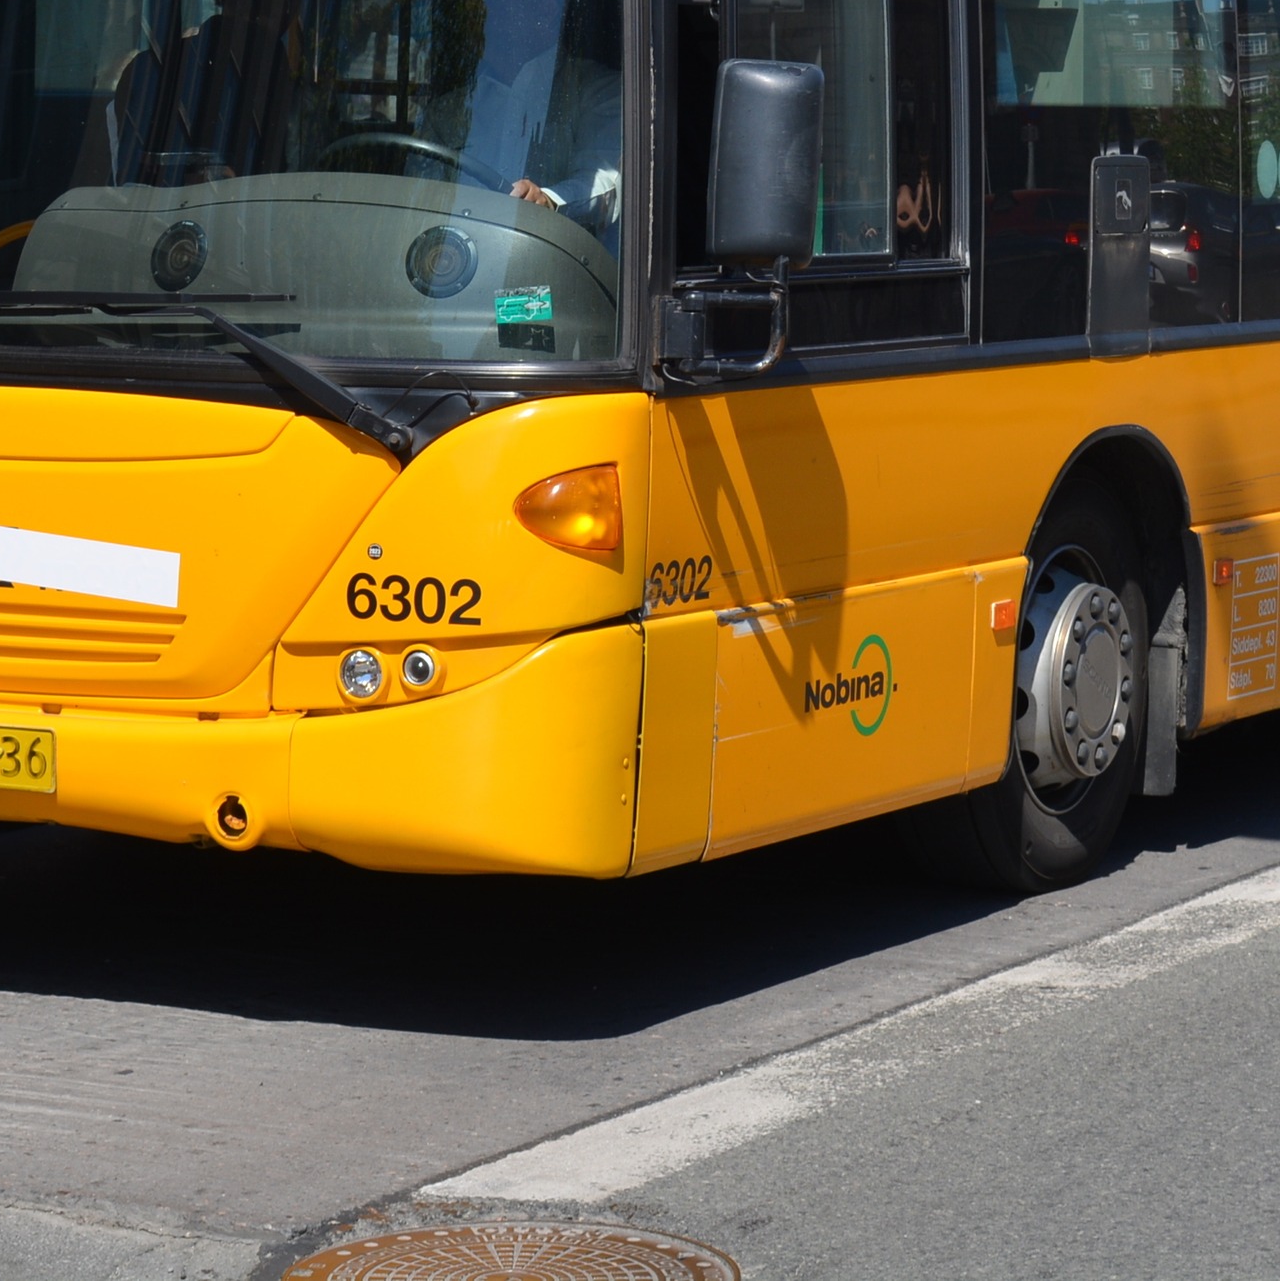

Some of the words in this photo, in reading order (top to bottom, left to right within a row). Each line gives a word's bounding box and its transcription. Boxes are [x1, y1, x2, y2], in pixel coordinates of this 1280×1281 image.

[648, 555, 713, 609] 6302
[1254, 563, 1278, 584] 22300
[346, 572, 482, 626] 6302
[1258, 597, 1277, 618] 8200
[1266, 629, 1275, 648] 43
[804, 671, 884, 714] Nobina
